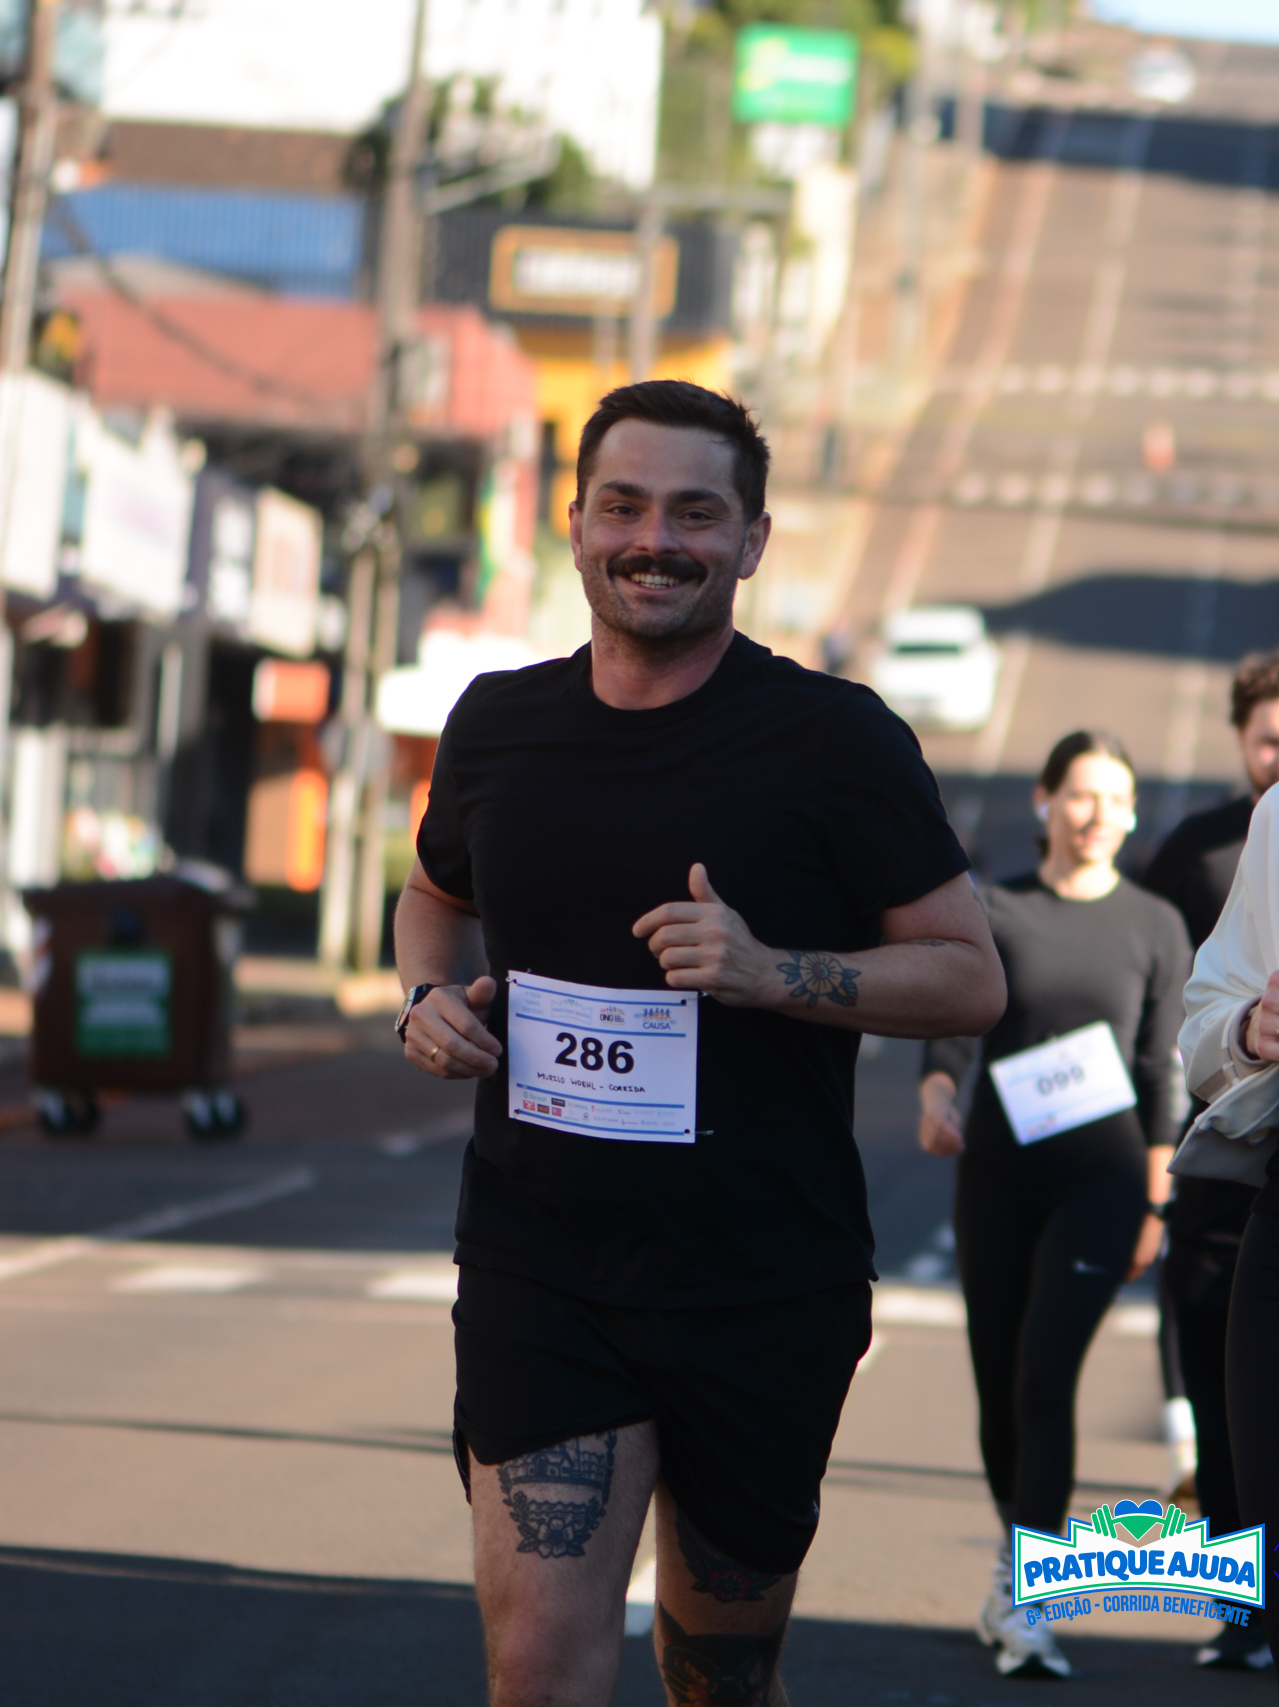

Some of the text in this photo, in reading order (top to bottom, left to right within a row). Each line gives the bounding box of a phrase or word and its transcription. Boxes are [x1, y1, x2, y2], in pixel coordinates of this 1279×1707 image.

[642, 1021, 671, 1030] CAUSA
[554, 1032, 635, 1074] 286
[609, 1084, 646, 1093] CORRIDA
